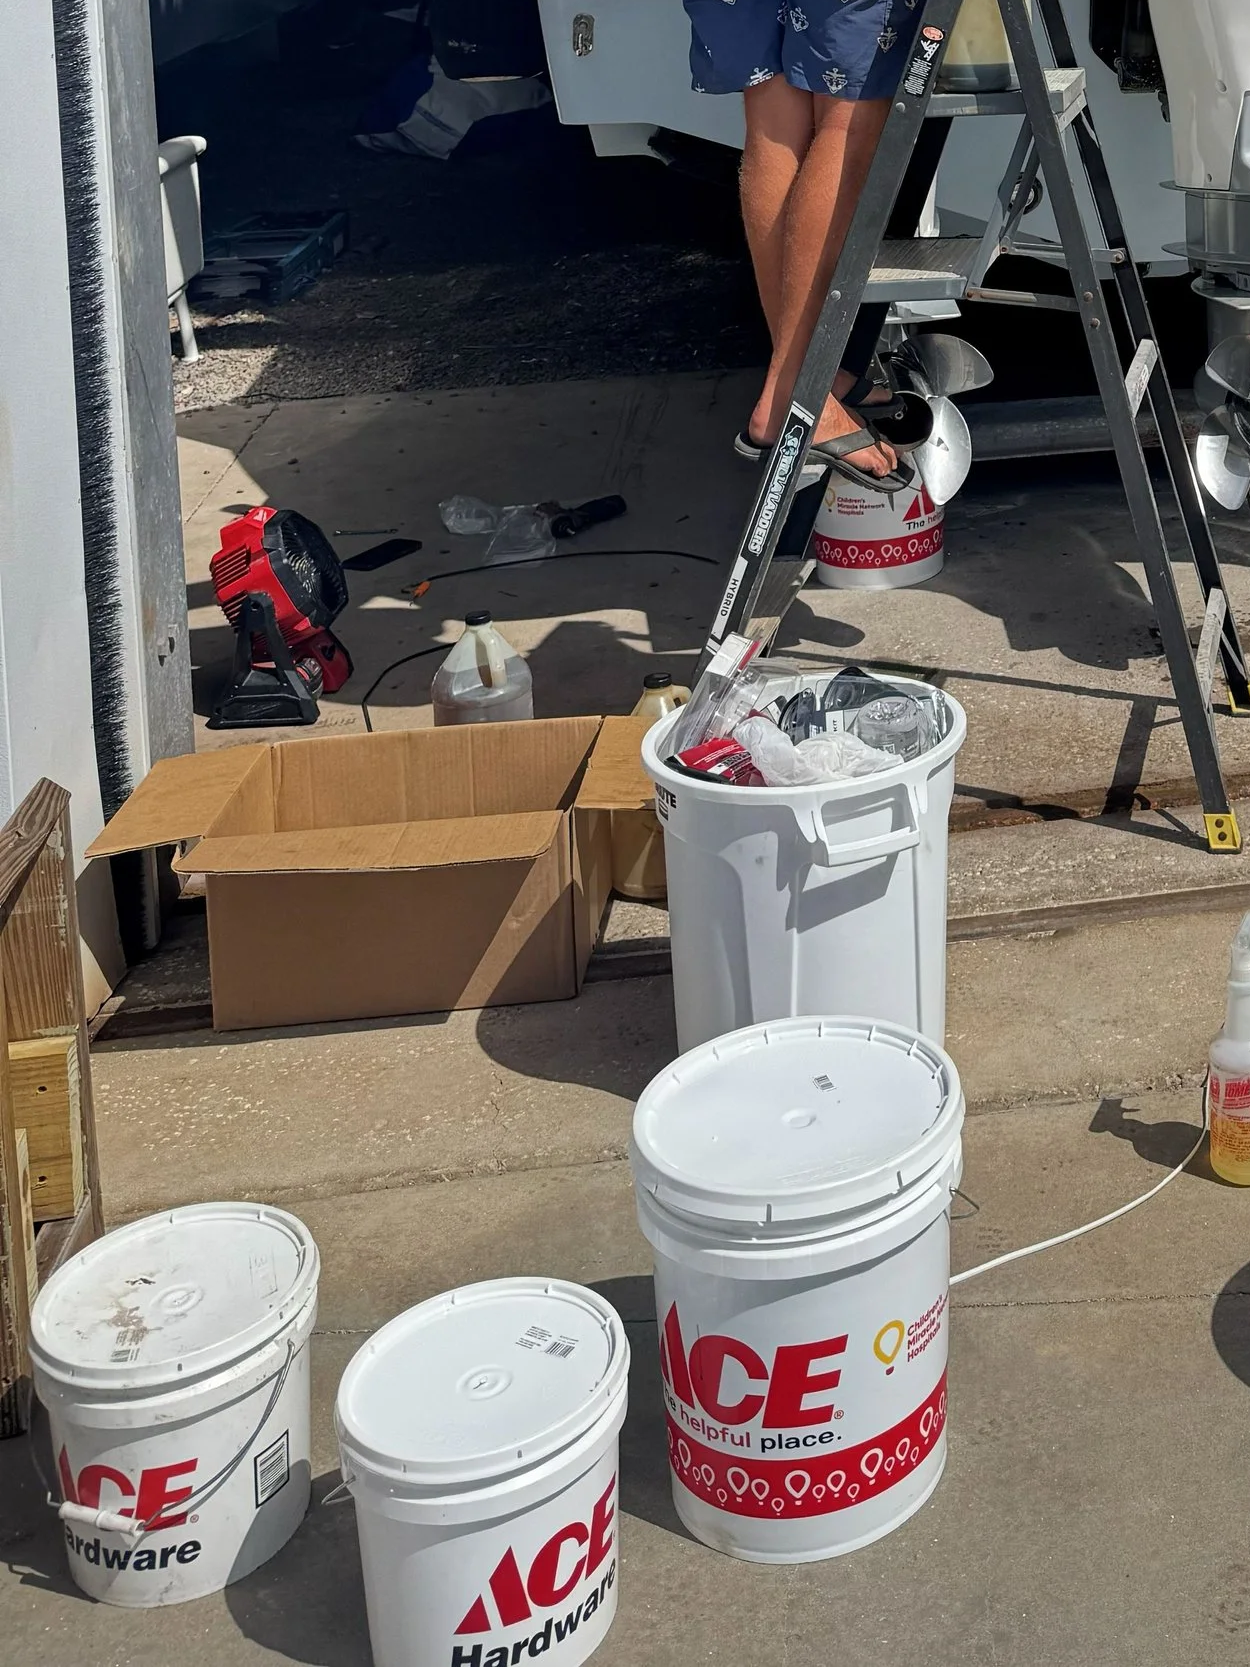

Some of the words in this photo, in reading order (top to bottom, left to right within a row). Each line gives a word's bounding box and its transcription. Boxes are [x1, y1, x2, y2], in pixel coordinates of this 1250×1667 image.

[720, 578, 739, 617] HYBRID
[907, 1293, 943, 1337] Children's
[907, 1315, 937, 1350] Miracle
[659, 1300, 849, 1429] ACE
[680, 1403, 751, 1449] helpful
[760, 1430, 843, 1454] place.
[66, 1526, 202, 1572] ardware
[453, 1470, 616, 1635] ACE
[451, 1557, 616, 1667] Hardware
